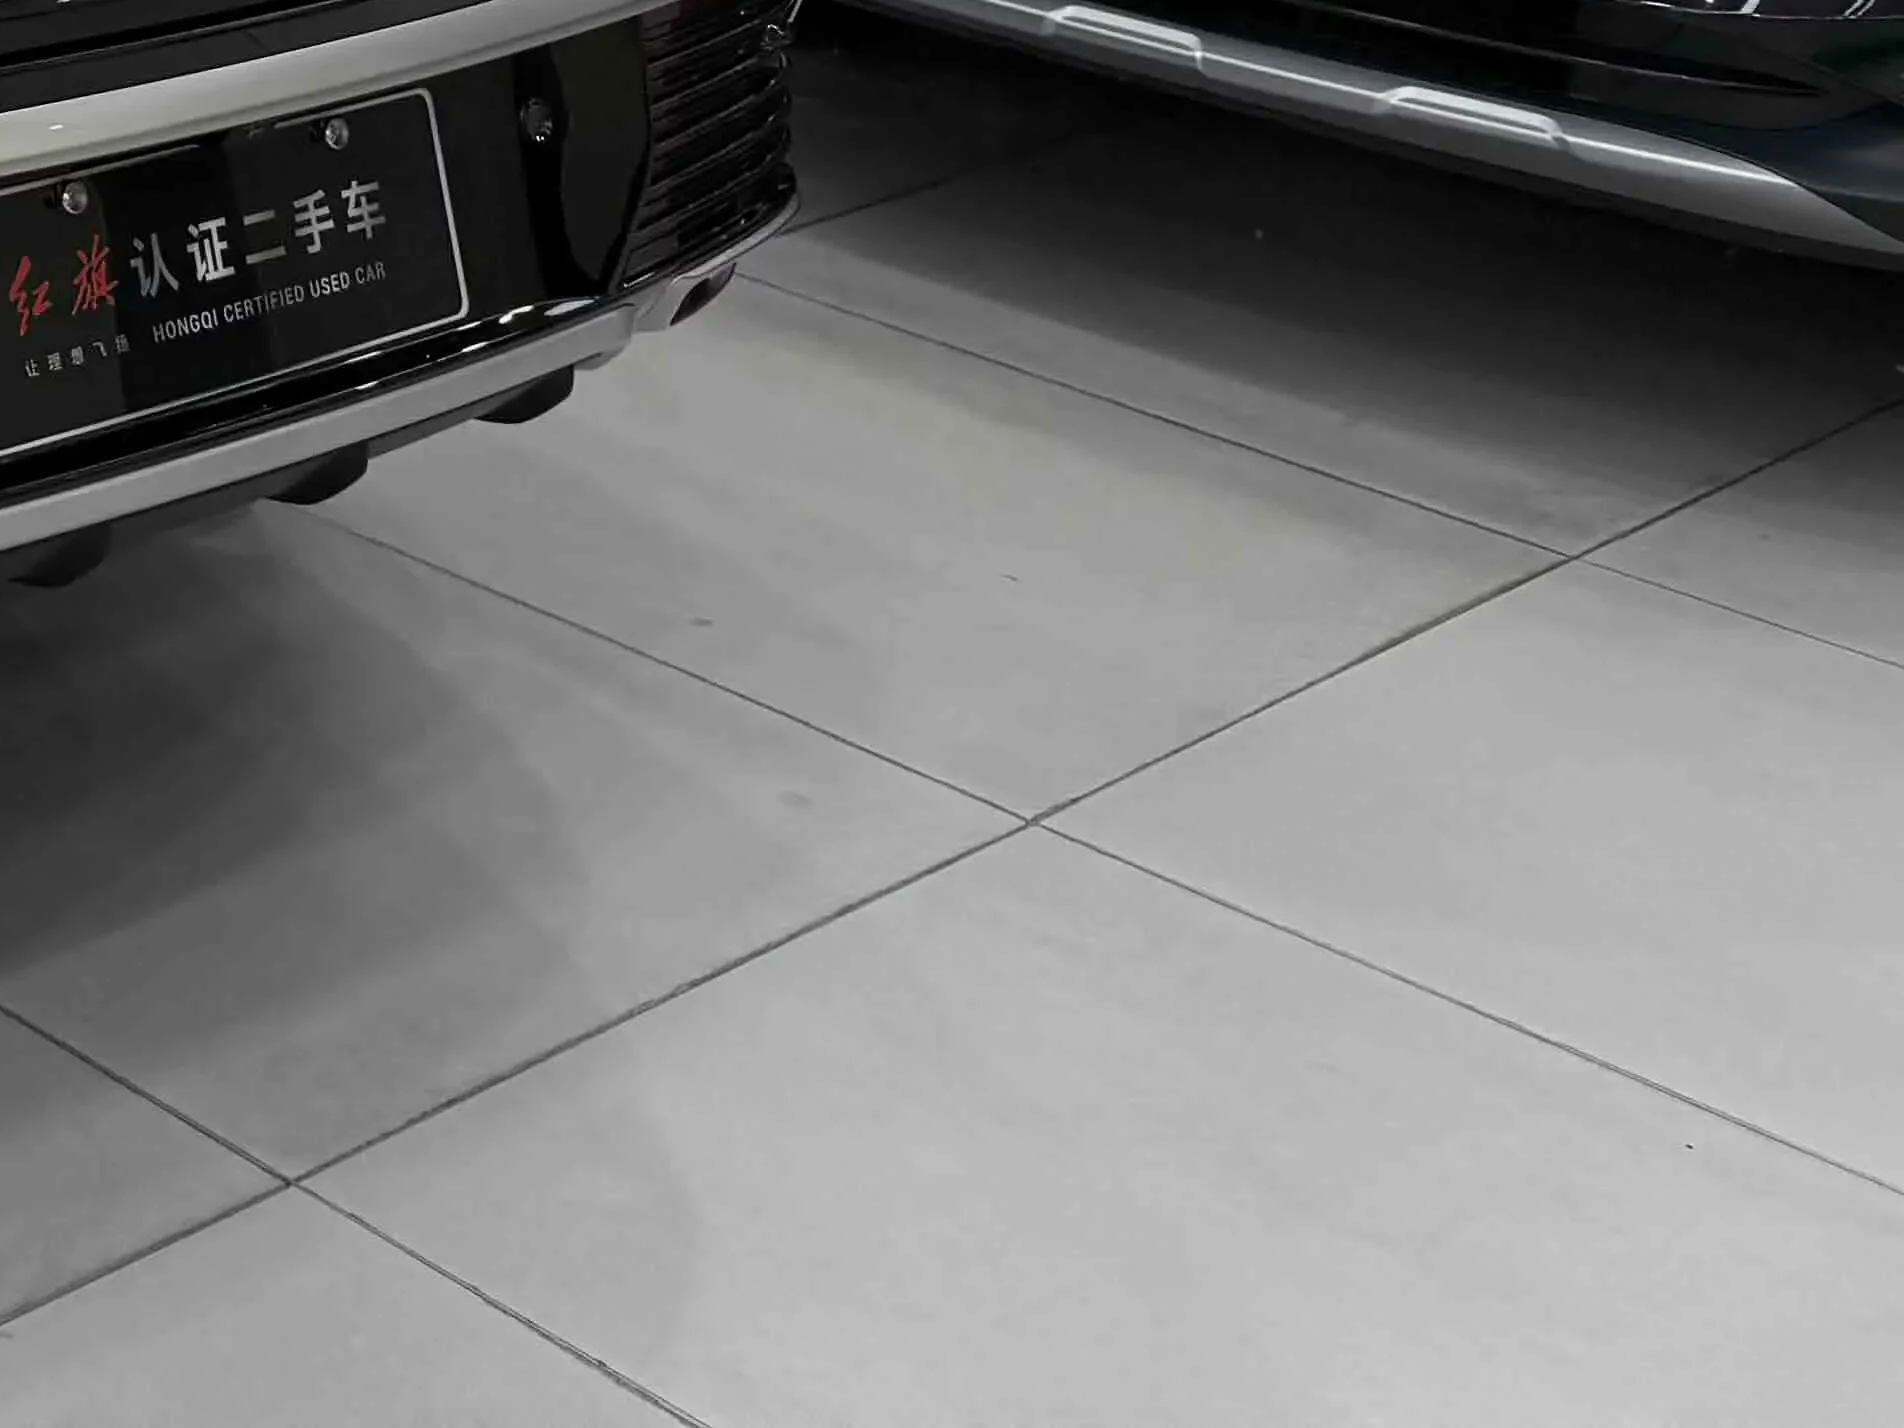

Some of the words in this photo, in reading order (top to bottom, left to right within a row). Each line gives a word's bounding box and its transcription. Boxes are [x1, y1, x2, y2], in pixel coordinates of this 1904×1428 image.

[152, 308, 219, 343] HONGQI
[223, 284, 305, 324] CERTIFIED
[309, 271, 351, 298] USED
[355, 261, 386, 285] CAR
